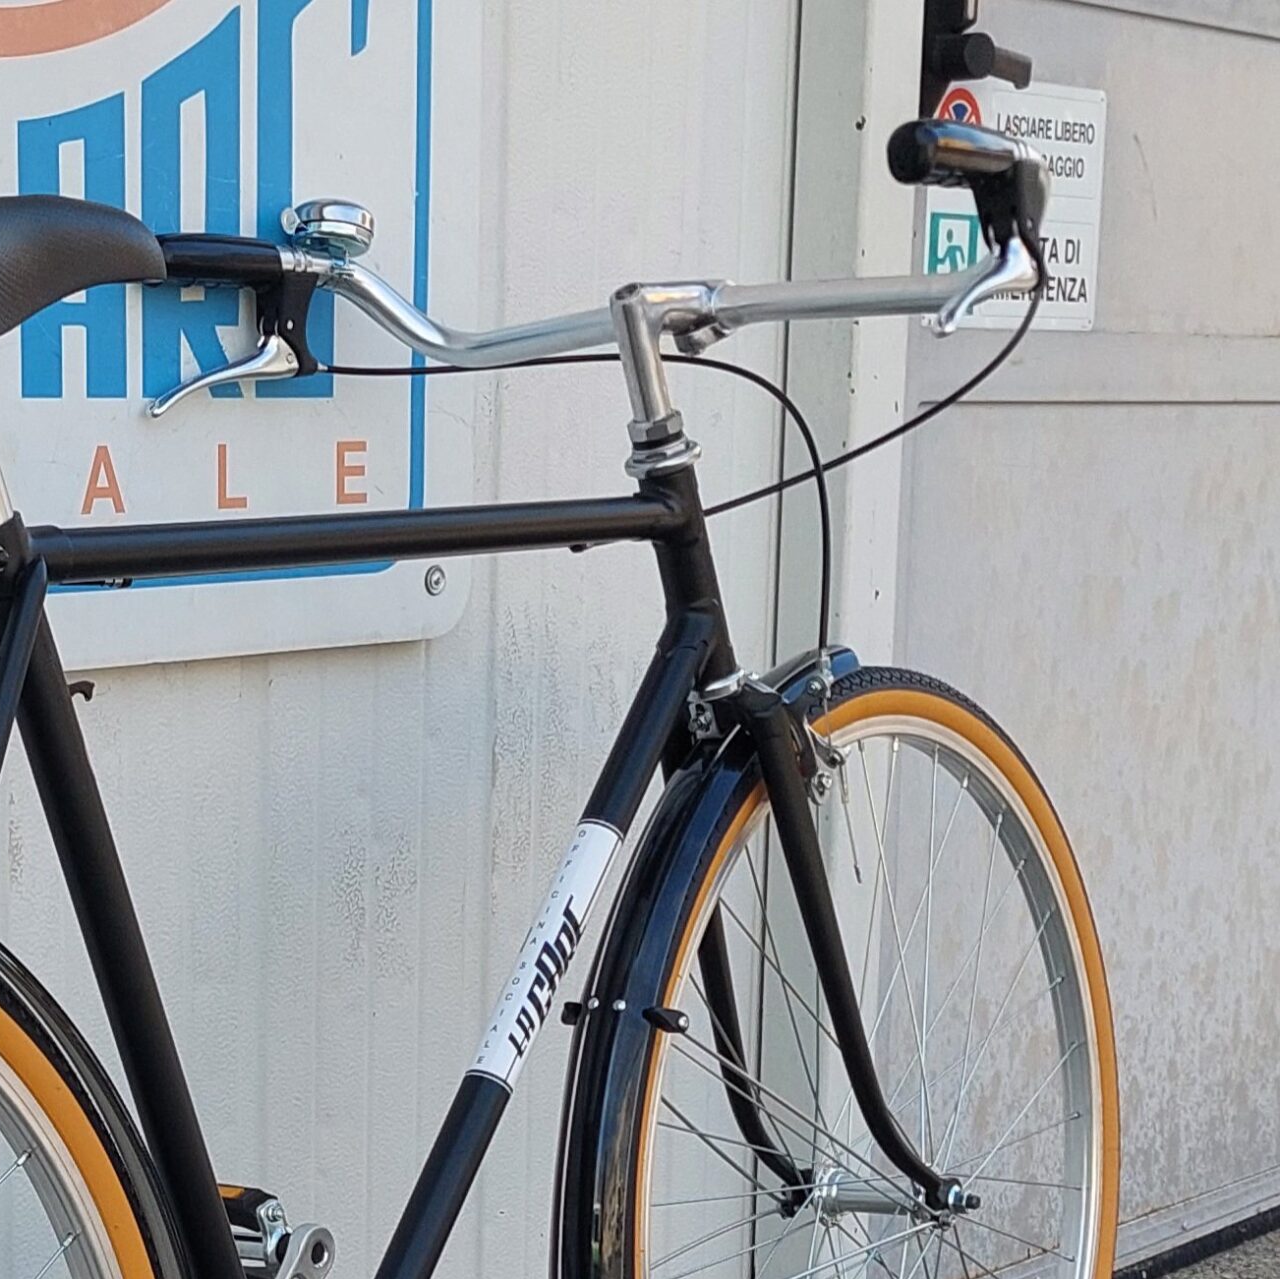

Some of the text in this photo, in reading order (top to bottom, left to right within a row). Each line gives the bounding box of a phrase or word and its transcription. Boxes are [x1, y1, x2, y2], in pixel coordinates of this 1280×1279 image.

[997, 112, 1095, 145] LASCIARE LIBERO
[1064, 239, 1081, 265] DI
[476, 961, 527, 1064] SOCIALE
